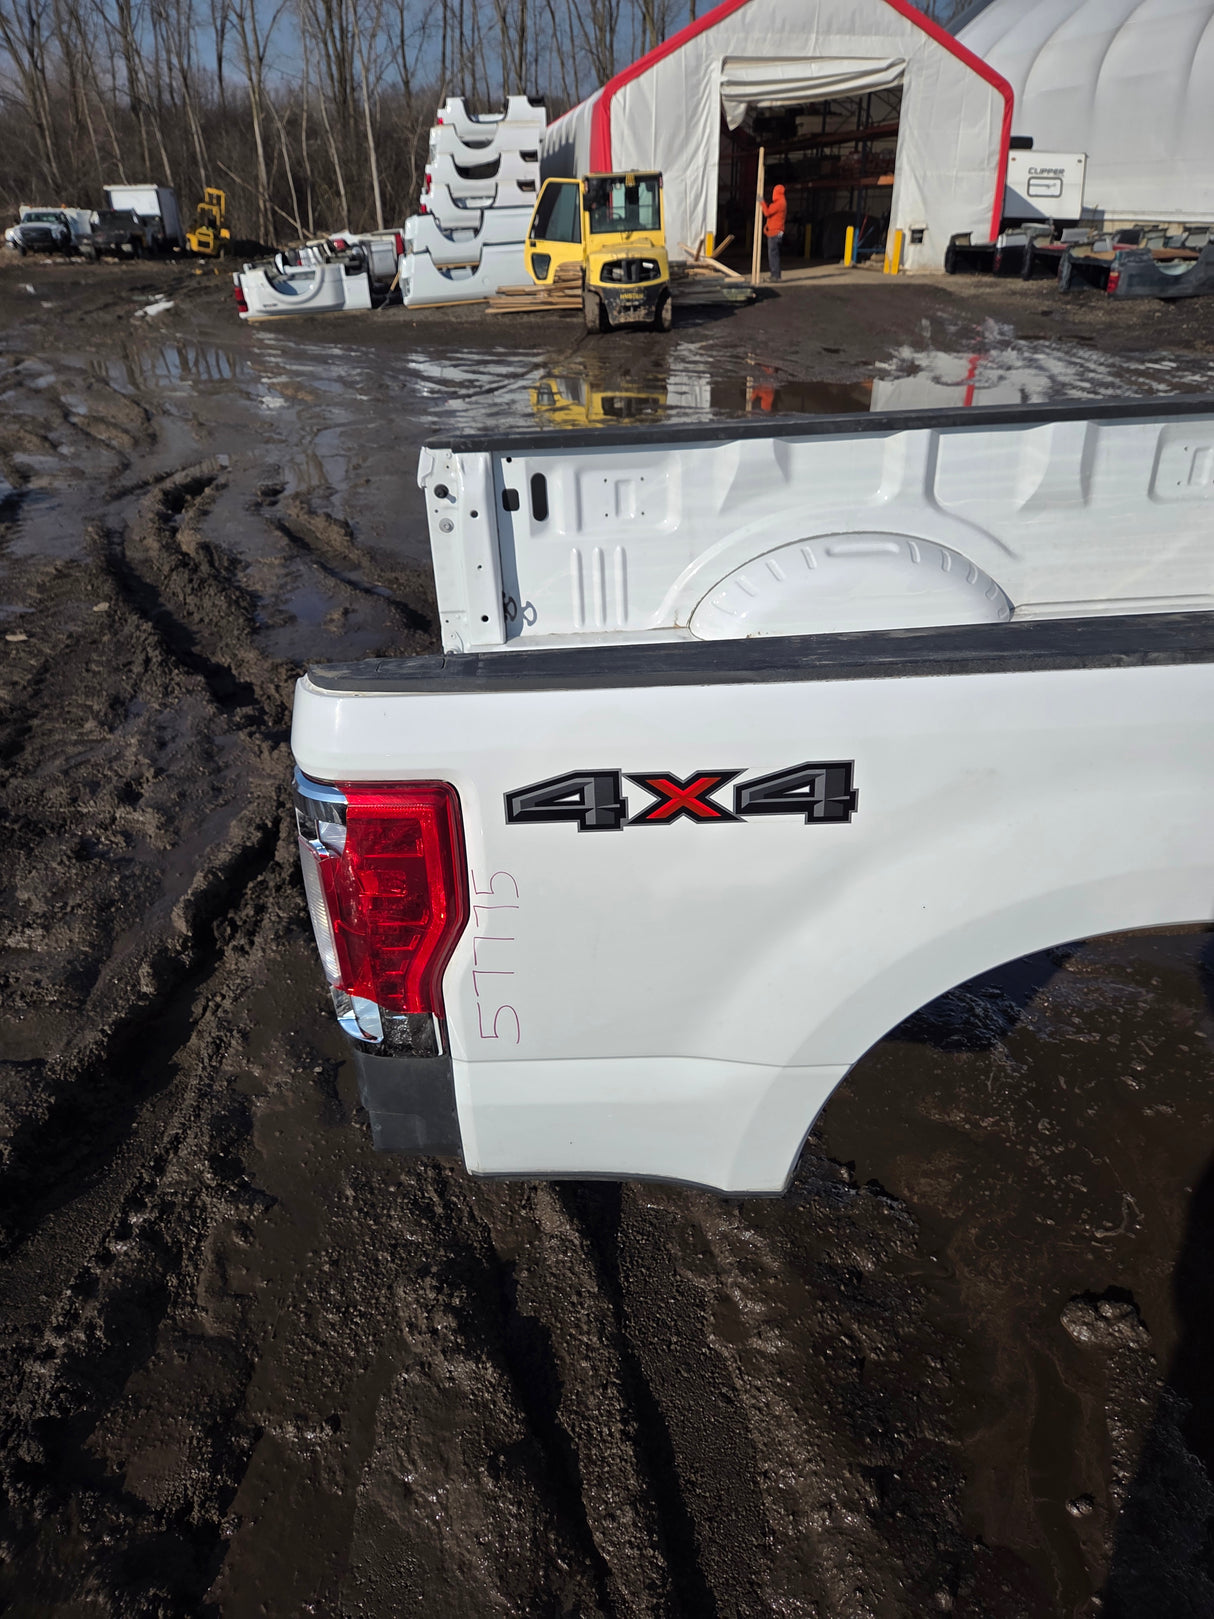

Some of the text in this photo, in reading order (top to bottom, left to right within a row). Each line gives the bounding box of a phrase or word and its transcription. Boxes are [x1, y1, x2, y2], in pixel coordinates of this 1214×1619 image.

[1028, 167, 1065, 176] CLIPPER
[503, 759, 859, 832] 4X4
[471, 869, 521, 1045] 57775
